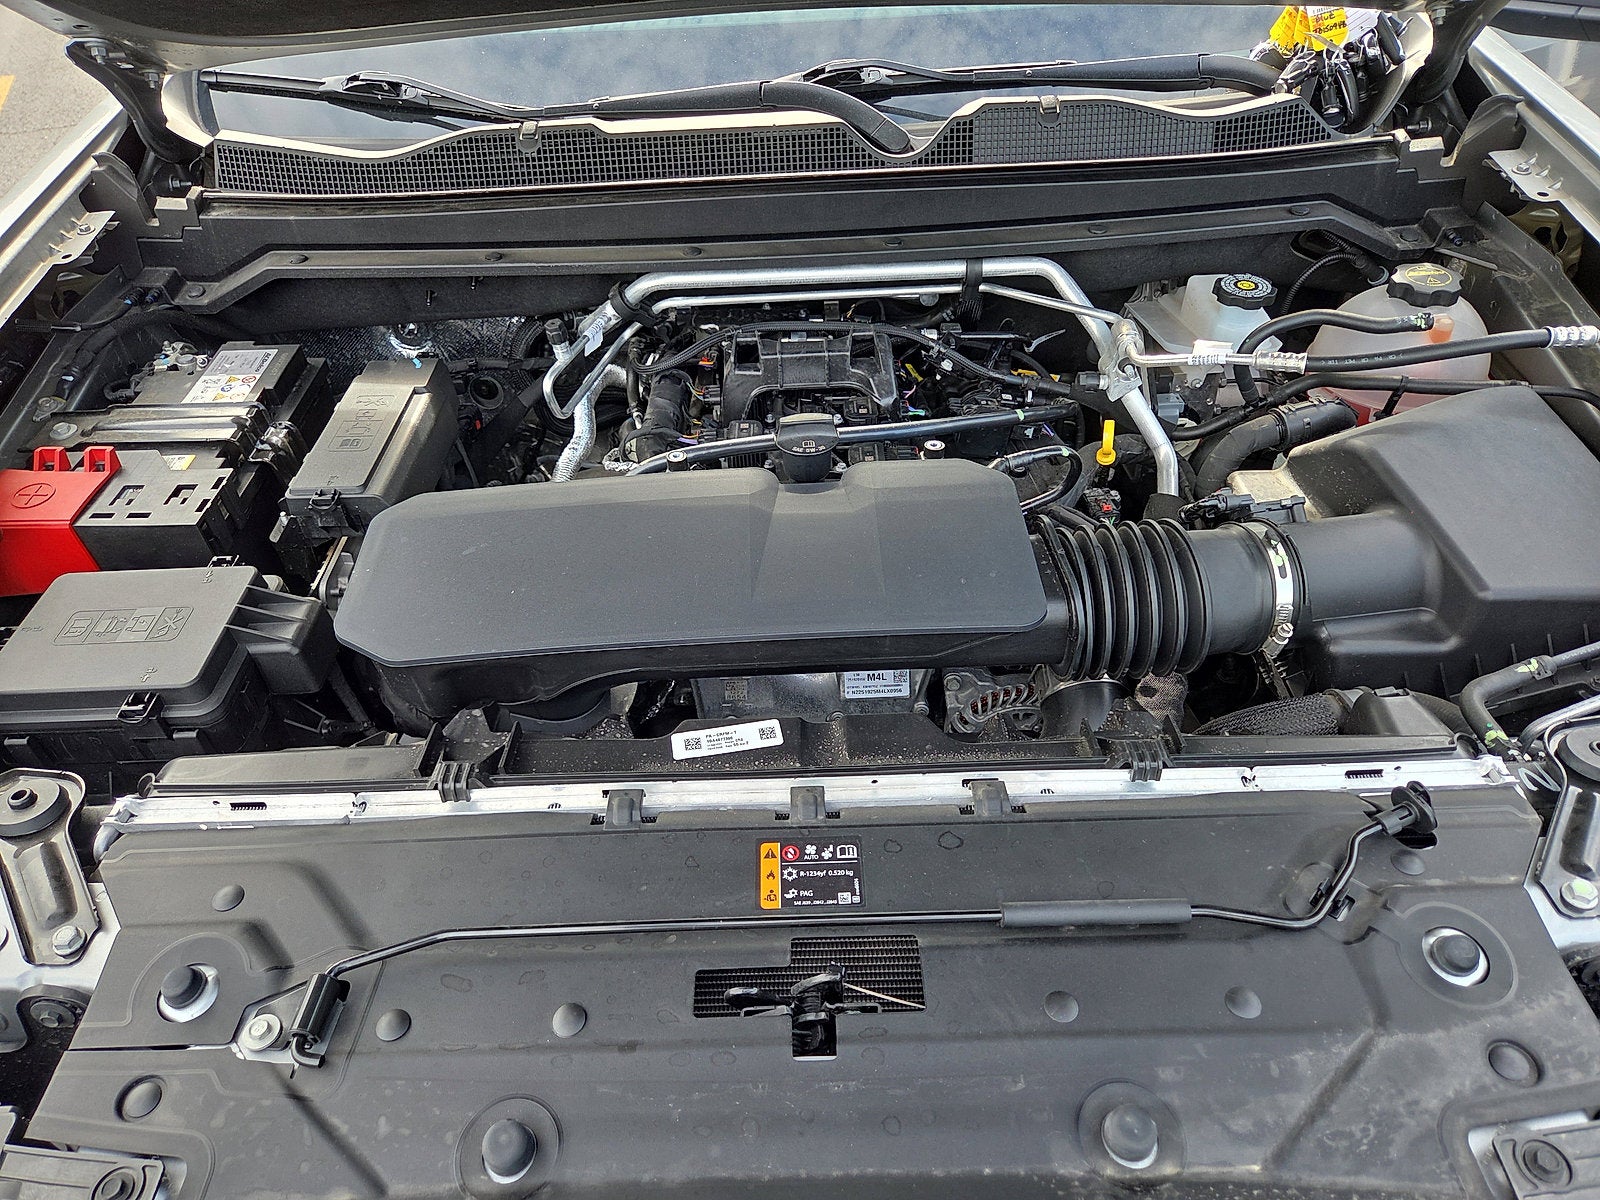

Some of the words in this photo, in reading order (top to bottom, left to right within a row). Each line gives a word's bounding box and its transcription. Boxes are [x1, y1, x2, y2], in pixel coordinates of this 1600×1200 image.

[867, 672, 888, 682] M4L
[800, 870, 826, 878] R-1234yf
[828, 869, 846, 877] 0.520
[846, 869, 854, 877] kg
